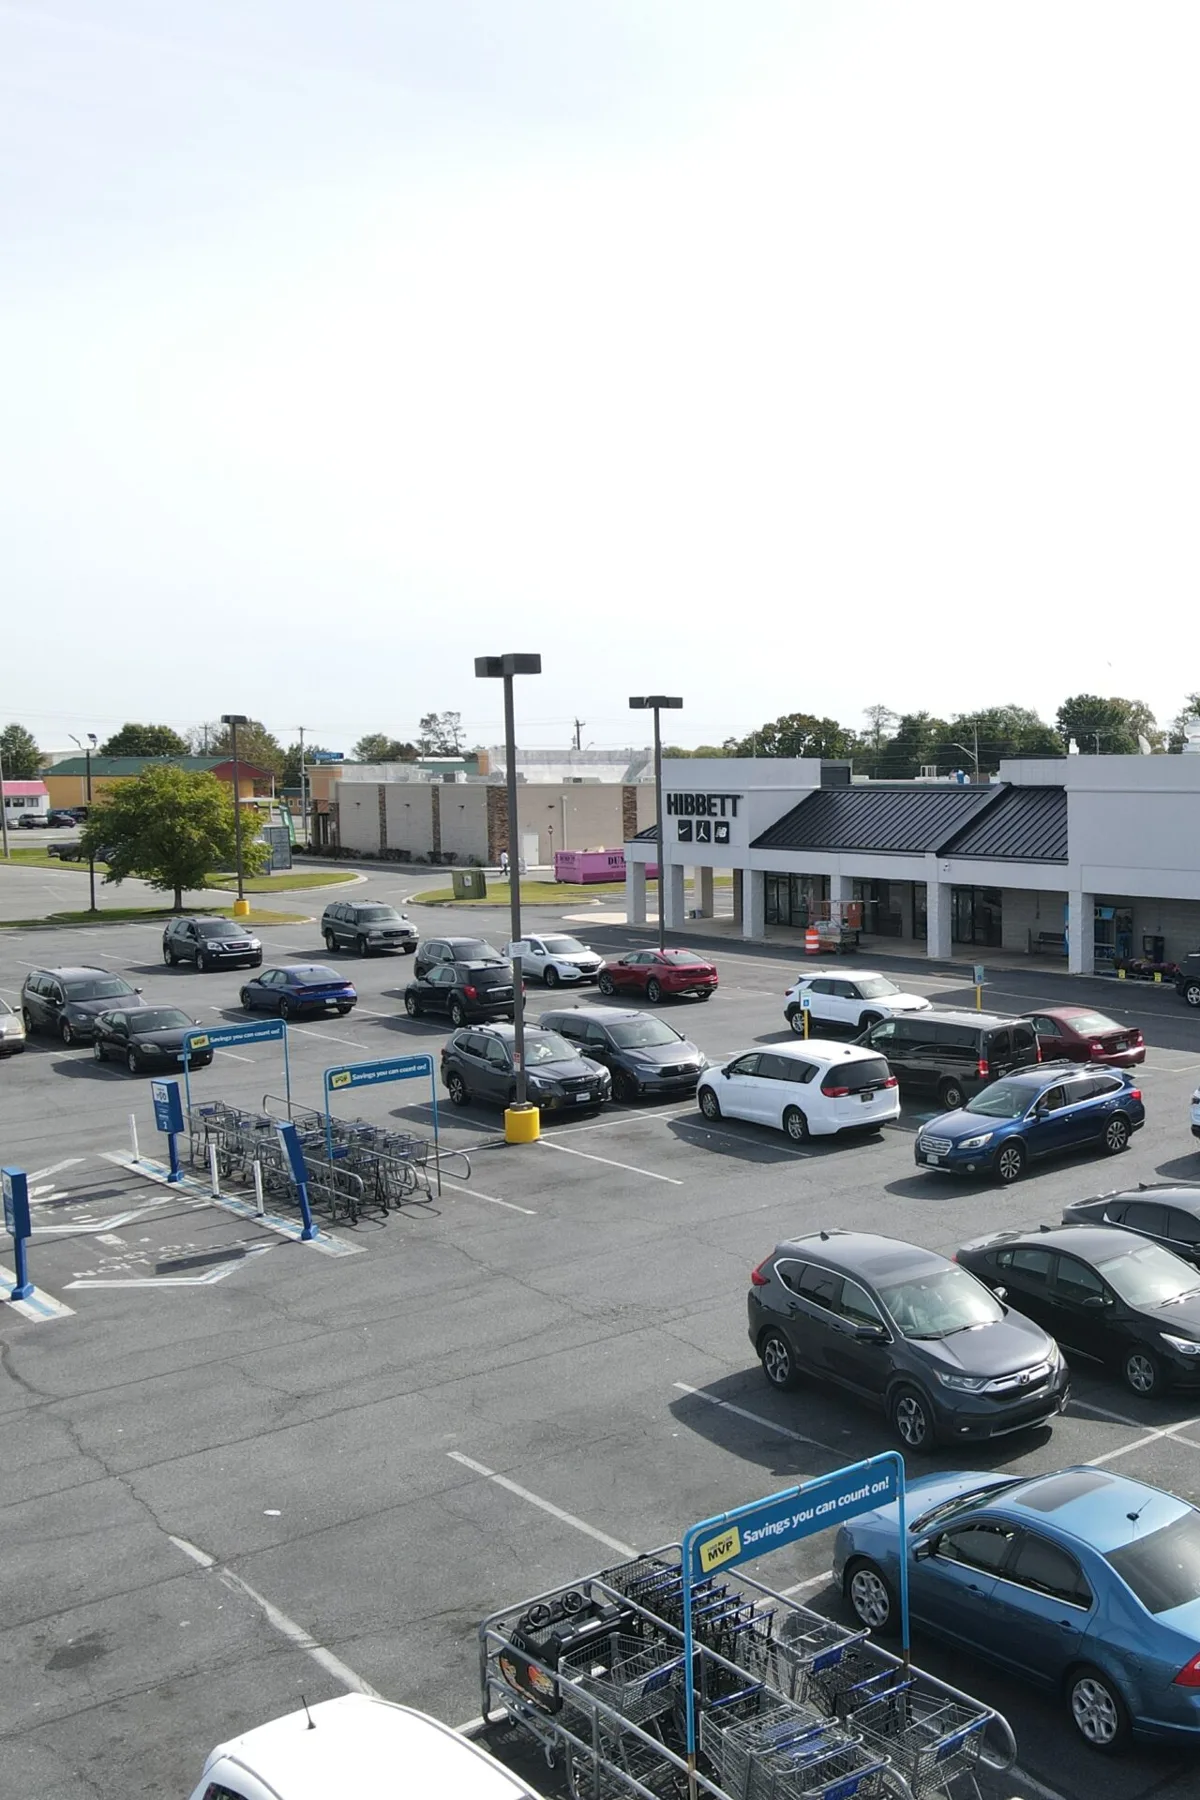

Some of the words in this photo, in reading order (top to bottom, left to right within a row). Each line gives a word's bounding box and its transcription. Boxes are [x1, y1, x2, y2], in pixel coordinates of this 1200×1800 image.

[666, 793, 742, 817] HIBBETT
[351, 1071, 376, 1081] Savings
[376, 1069, 388, 1078] you
[388, 1067, 399, 1075] can
[399, 1064, 417, 1073] count
[742, 1517, 791, 1545] Savings
[792, 1508, 815, 1529] you
[815, 1499, 837, 1516] can
[838, 1484, 871, 1507] count
[871, 1476, 890, 1494] on!
[708, 1540, 734, 1563] MVP
